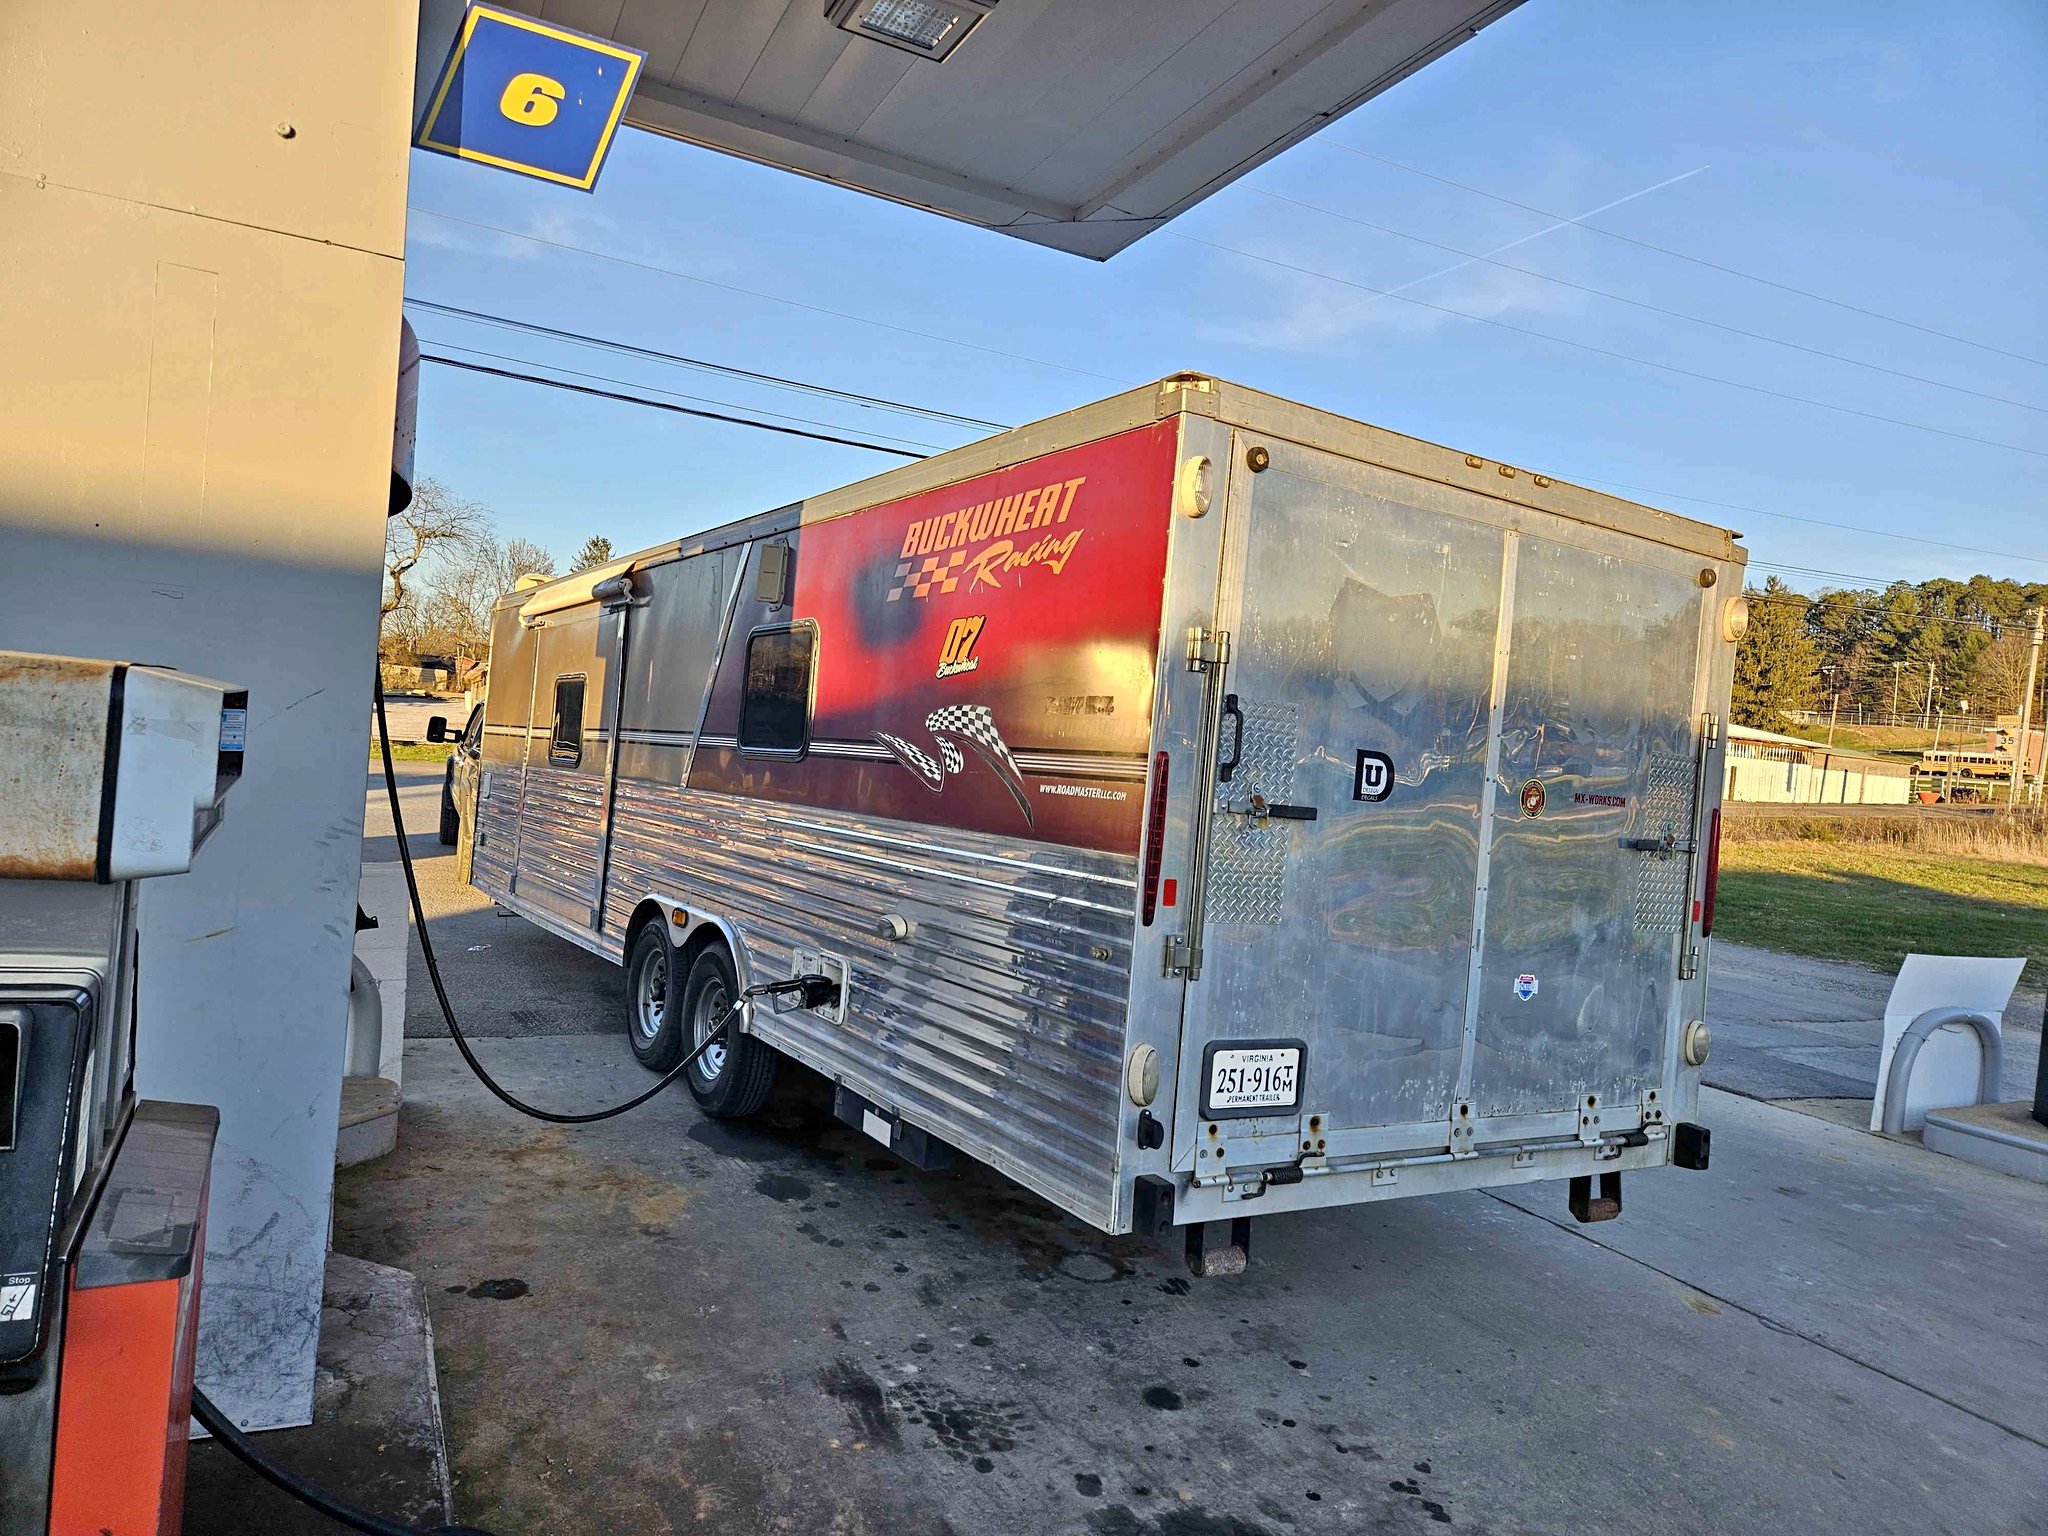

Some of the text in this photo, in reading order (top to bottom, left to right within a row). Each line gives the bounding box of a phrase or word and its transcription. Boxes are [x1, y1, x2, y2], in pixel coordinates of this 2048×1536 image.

[500, 72, 566, 127] 6
[900, 476, 1086, 559] BUCKWHEAT
[963, 528, 1085, 595] Racing
[939, 615, 986, 664] 07
[2000, 736, 2015, 745] 35
[1574, 793, 1626, 807] MX-WORKS.COM
[1241, 1054, 1274, 1062] VIRGINIA
[1215, 1066, 1282, 1094] 251-916
[1227, 1095, 1258, 1103] PERMANENT
[8, 1276, 31, 1285] Stop
